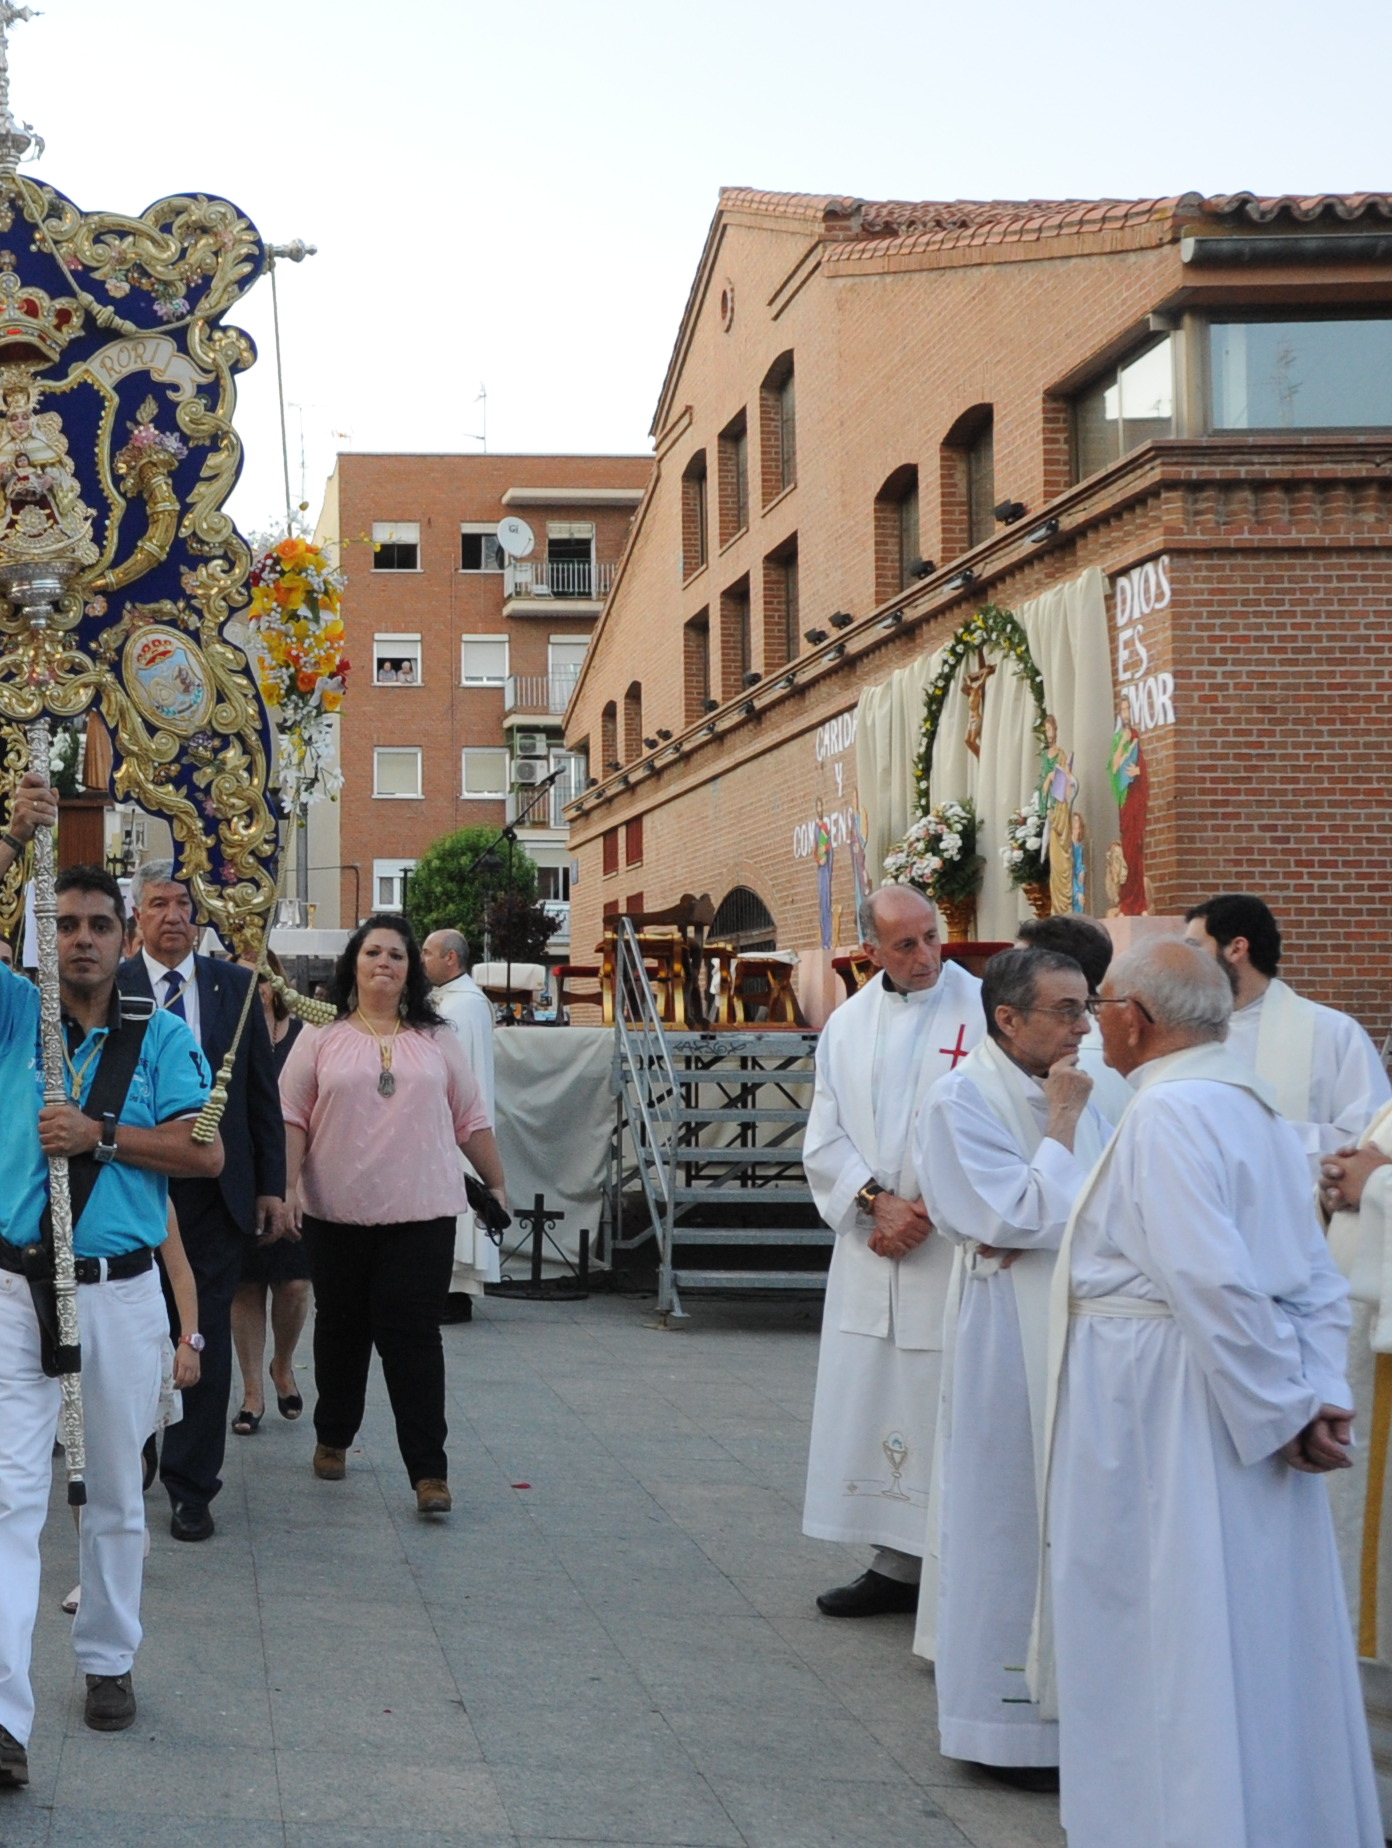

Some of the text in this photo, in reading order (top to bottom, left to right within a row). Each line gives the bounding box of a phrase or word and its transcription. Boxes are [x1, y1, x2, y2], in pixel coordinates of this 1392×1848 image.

[1116, 555, 1171, 627] DIOS
[1118, 624, 1148, 682] ES
[815, 707, 859, 762] CARIDA
[834, 761, 843, 798] Y
